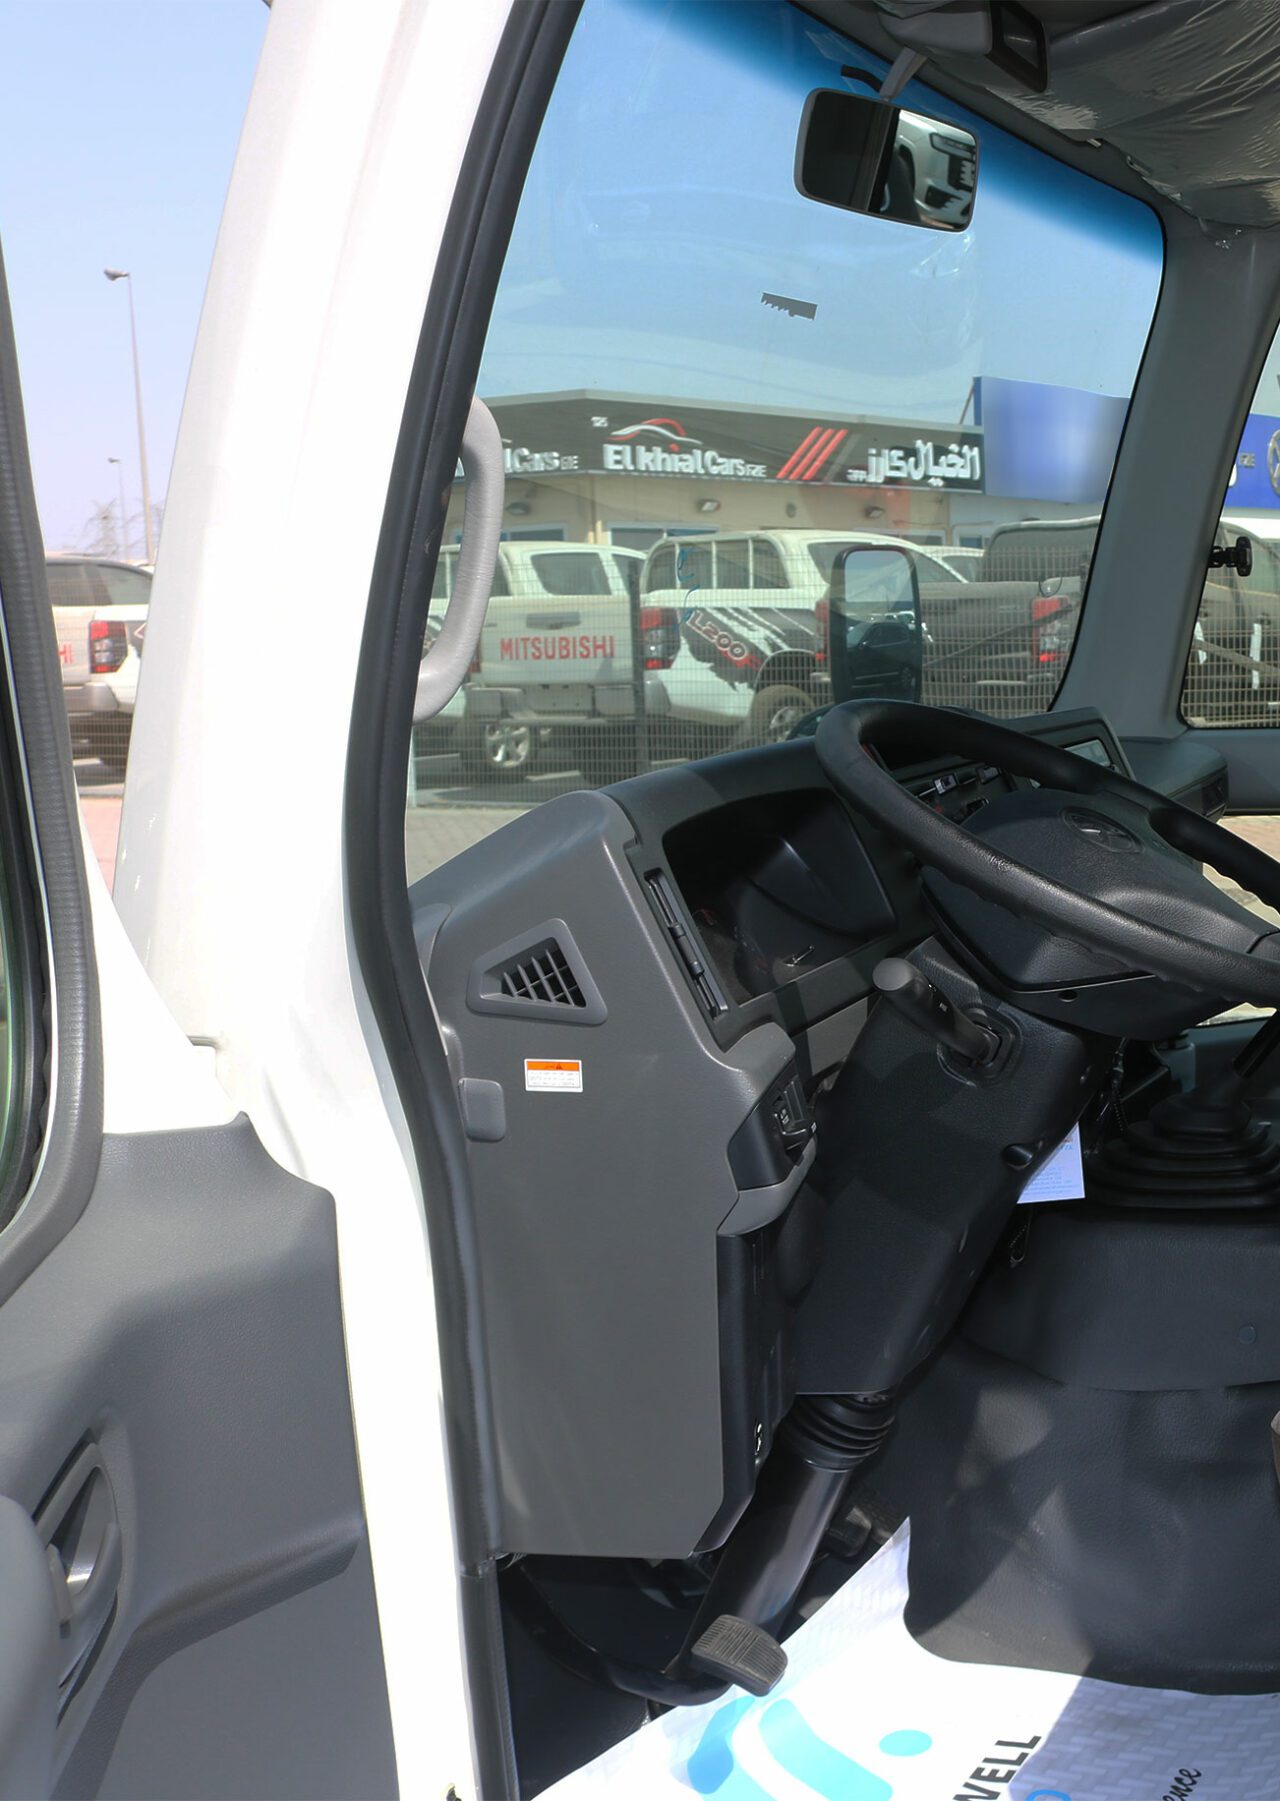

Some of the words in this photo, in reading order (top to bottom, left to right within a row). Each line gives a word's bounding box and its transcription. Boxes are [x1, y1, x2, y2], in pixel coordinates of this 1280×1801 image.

[602, 443, 635, 471] El
[704, 449, 745, 476] Cars
[908, 439, 981, 487] الخيال
[500, 635, 616, 661] MITSUBISHI
[686, 609, 748, 661] L200
